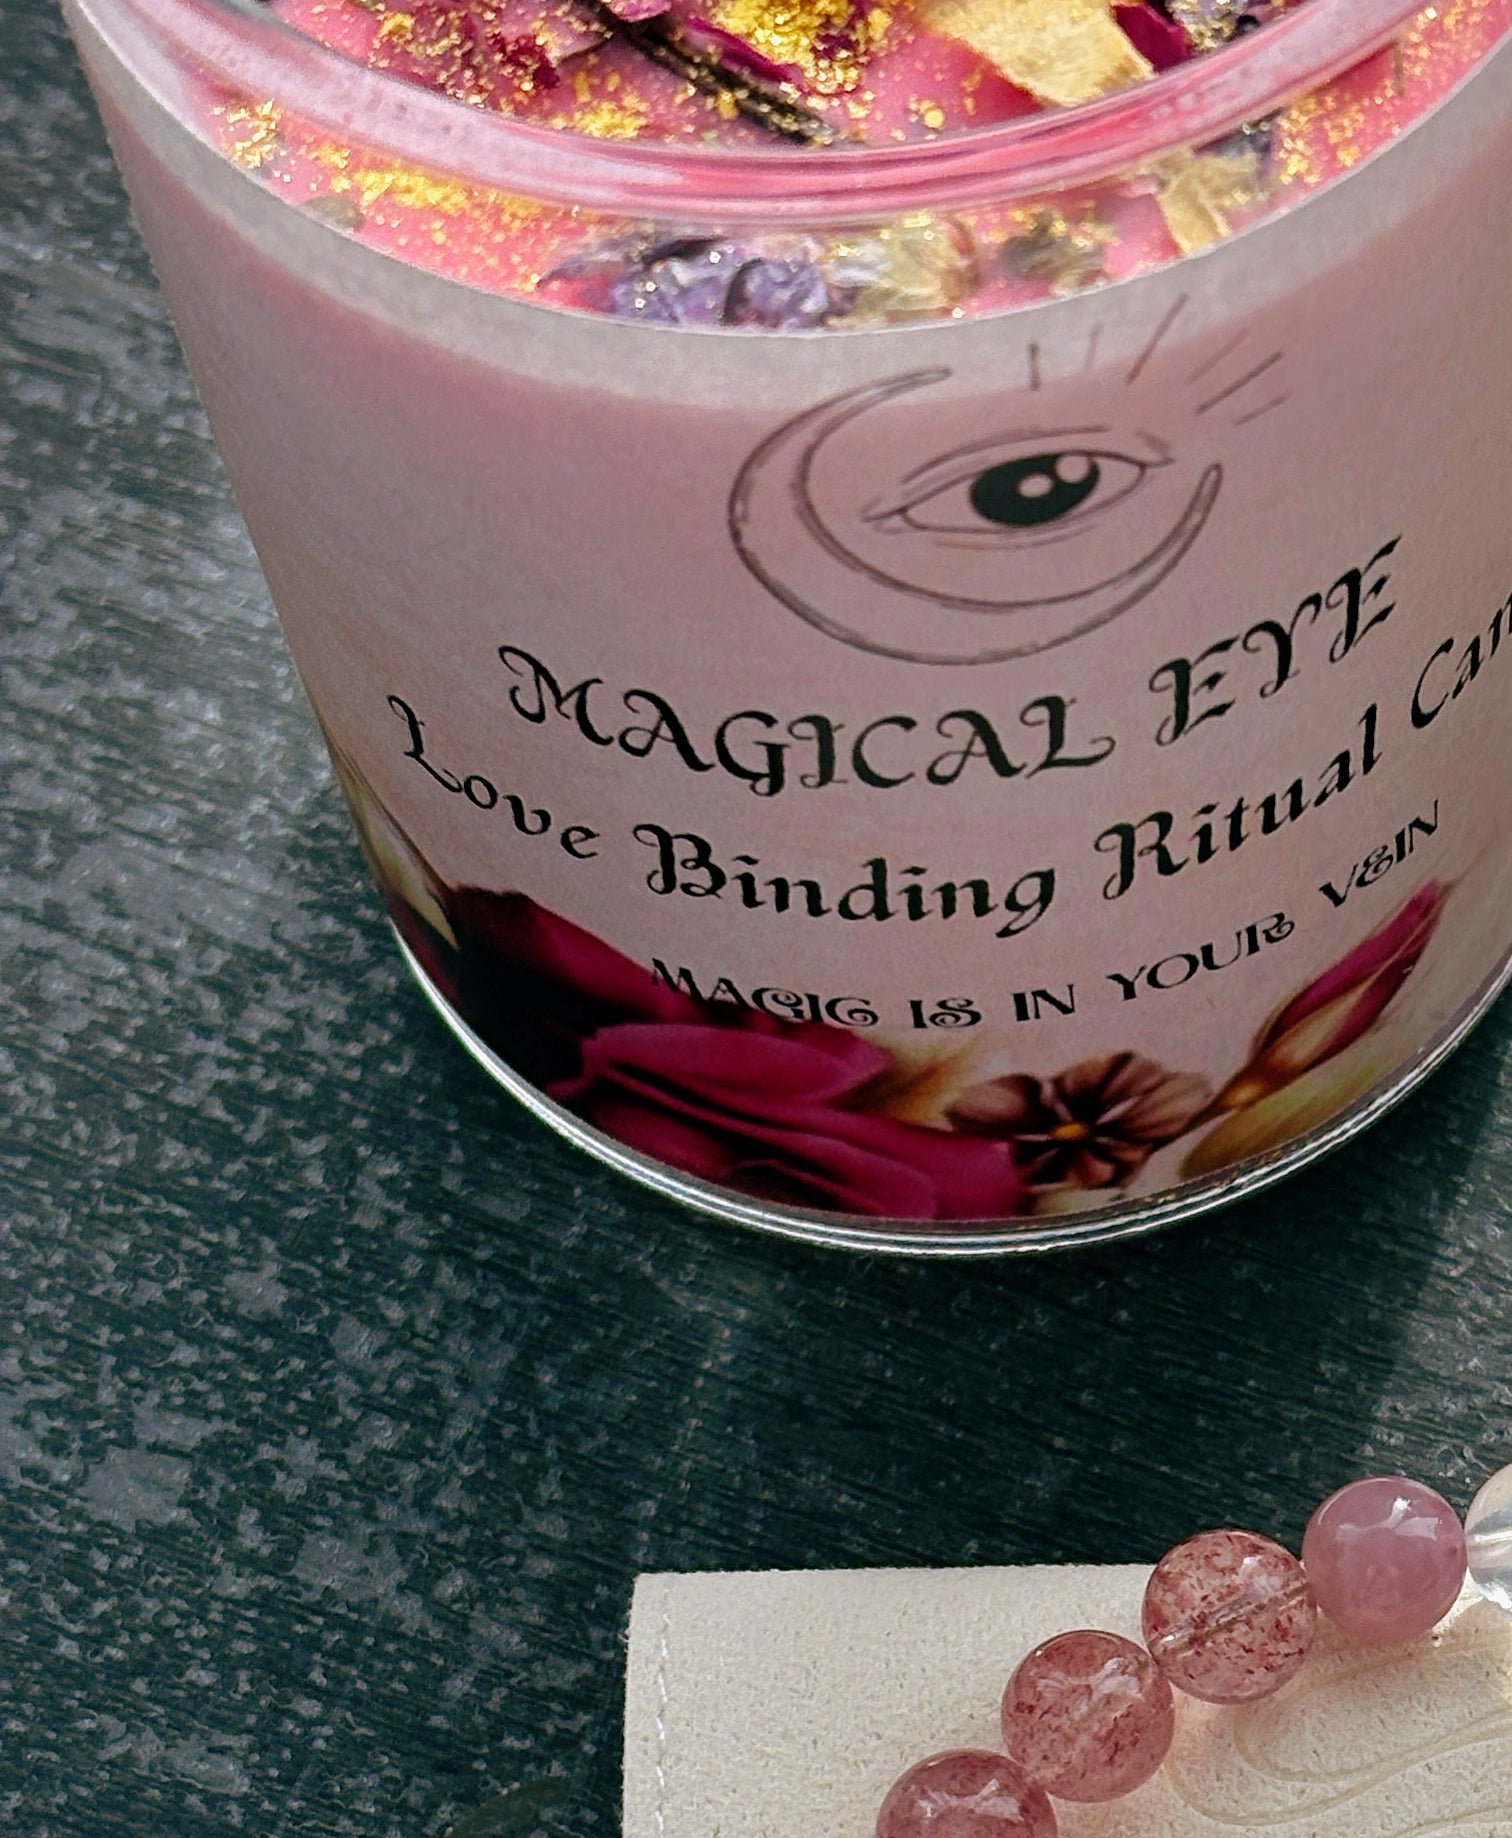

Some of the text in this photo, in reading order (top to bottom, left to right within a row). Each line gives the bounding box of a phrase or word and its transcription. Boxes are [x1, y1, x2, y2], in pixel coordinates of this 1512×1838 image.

[497, 534, 1402, 797] MAGICAL EYE
[387, 693, 601, 862] Love
[633, 822, 1056, 939] Binding
[1094, 701, 1383, 900] Ritual
[650, 798, 1439, 1029] MAGIC IS IN YOUR VEIN
